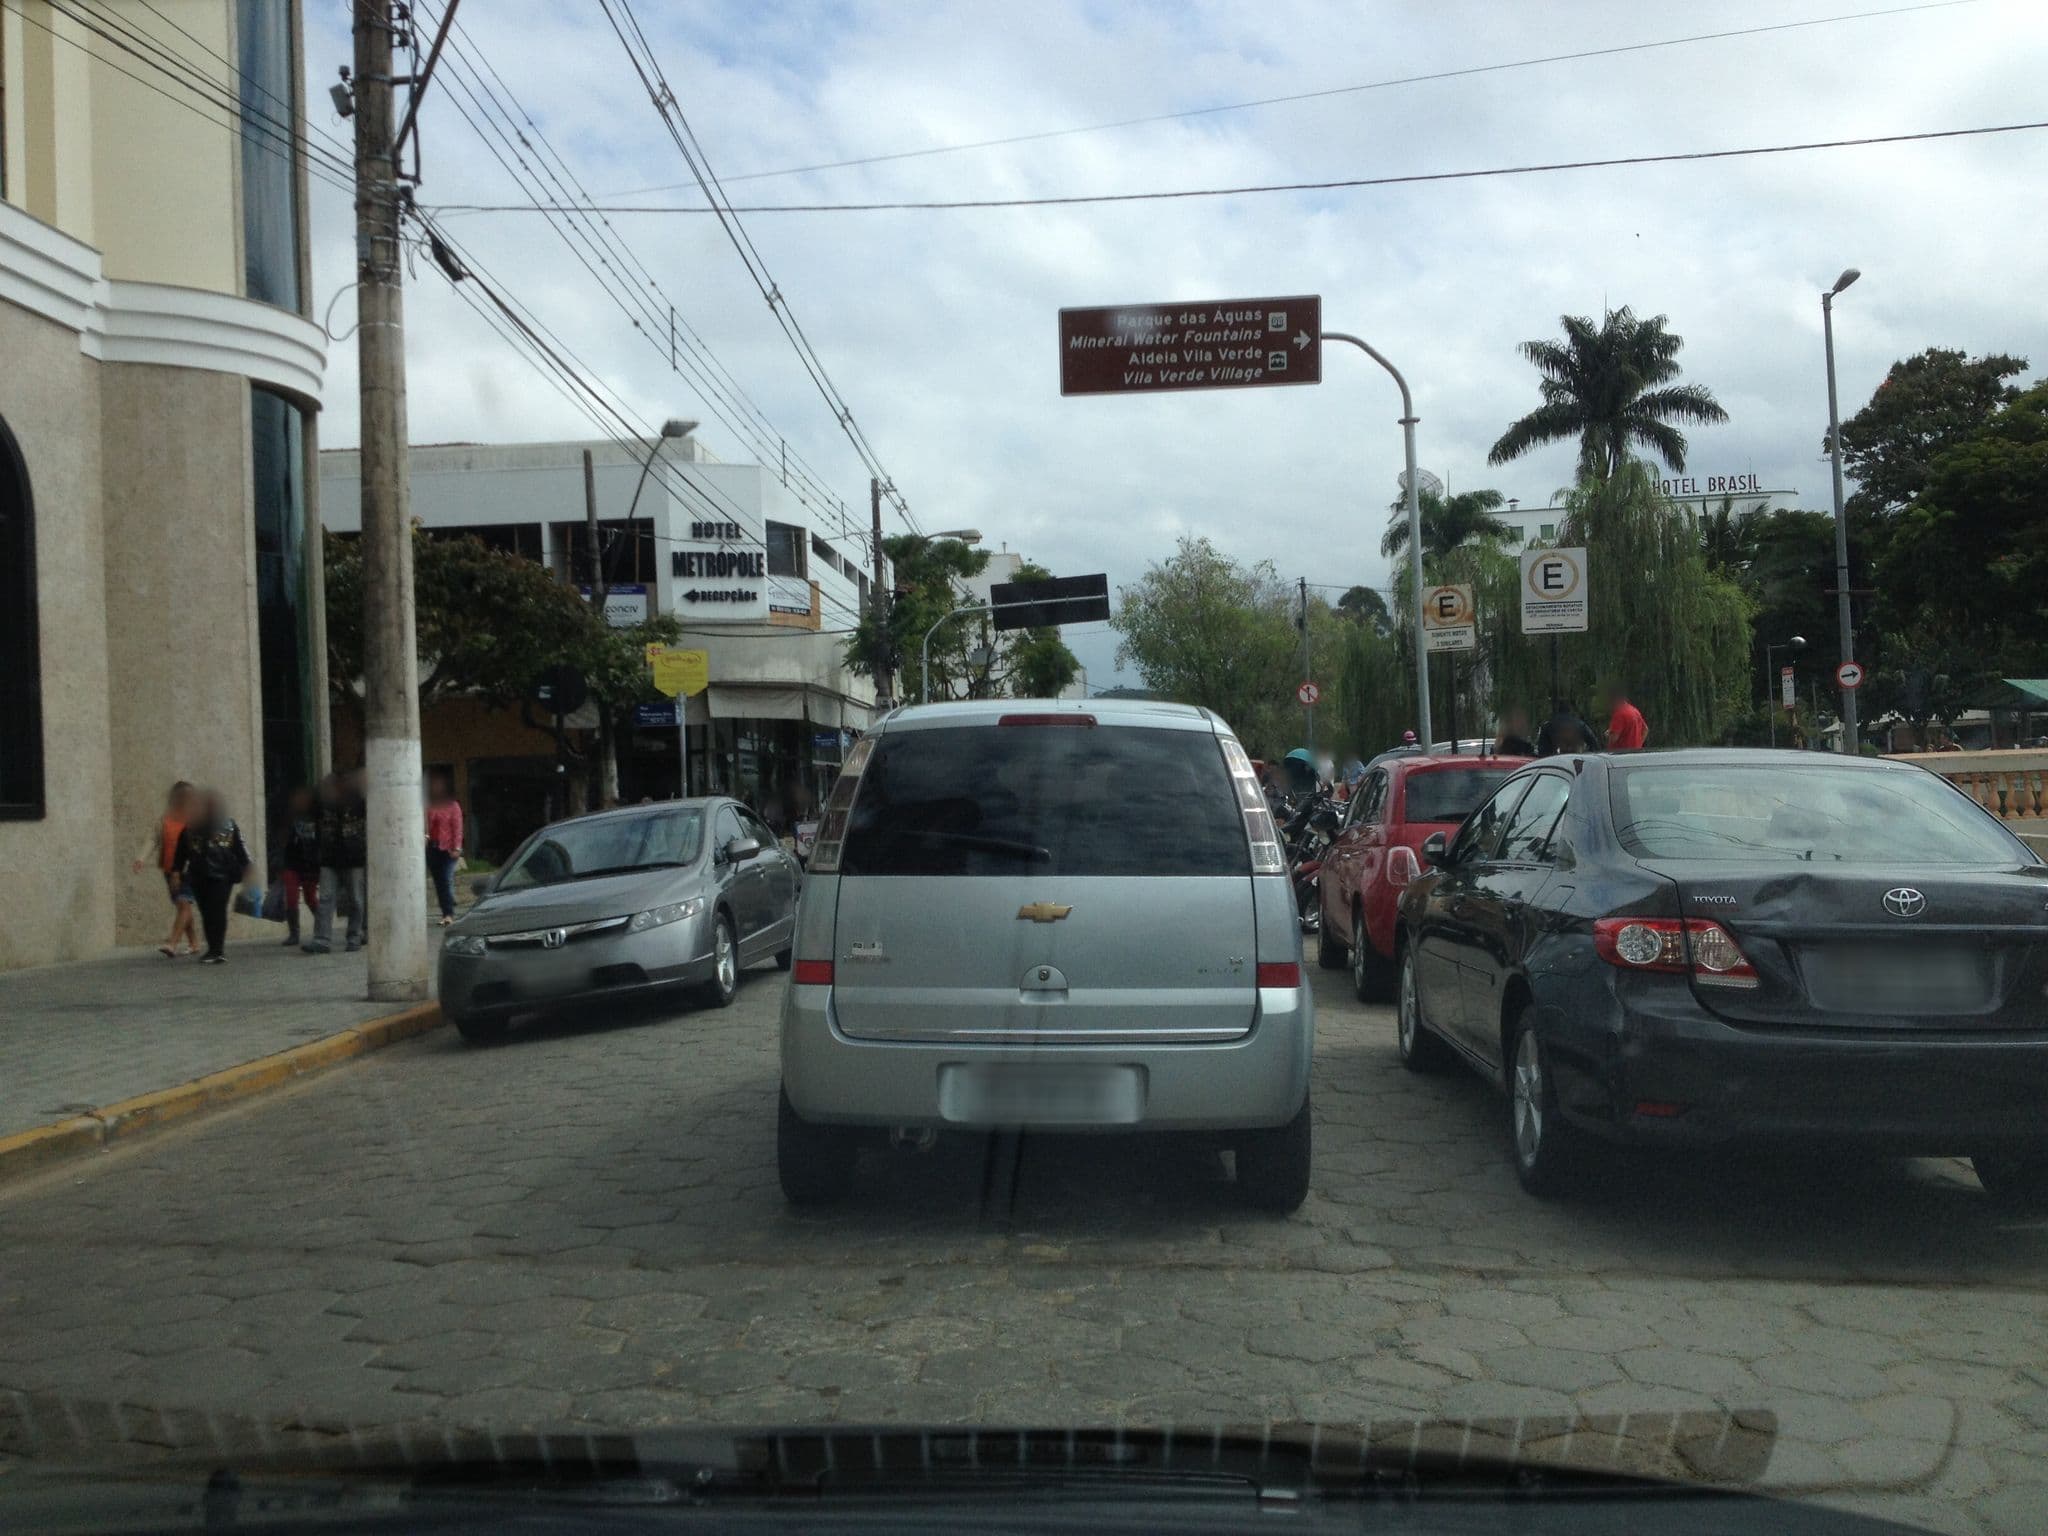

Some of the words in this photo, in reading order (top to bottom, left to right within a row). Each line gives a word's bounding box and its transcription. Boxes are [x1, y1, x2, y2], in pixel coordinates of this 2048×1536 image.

[1117, 314, 1172, 328] Parque
[1180, 312, 1207, 324] das
[1213, 305, 1262, 326] Águas
[1070, 333, 1129, 349] Mineral
[1134, 332, 1179, 346] Water
[1184, 328, 1262, 343] Fountains
[1128, 351, 1178, 365] Aldeia
[1183, 349, 1213, 362] Vila
[1218, 346, 1263, 361] Verde
[1123, 371, 1153, 385] Vila
[1160, 368, 1205, 382] Verde
[1210, 366, 1263, 382] Village
[1652, 477, 1700, 495] HOTEL
[1708, 473, 1762, 492] BRASIL
[692, 521, 742, 539] HOTEL
[672, 544, 765, 578] METRÓPOLE
[1543, 562, 1564, 590] E
[1439, 595, 1456, 618] E
[1692, 895, 1737, 904] TOYOTA
